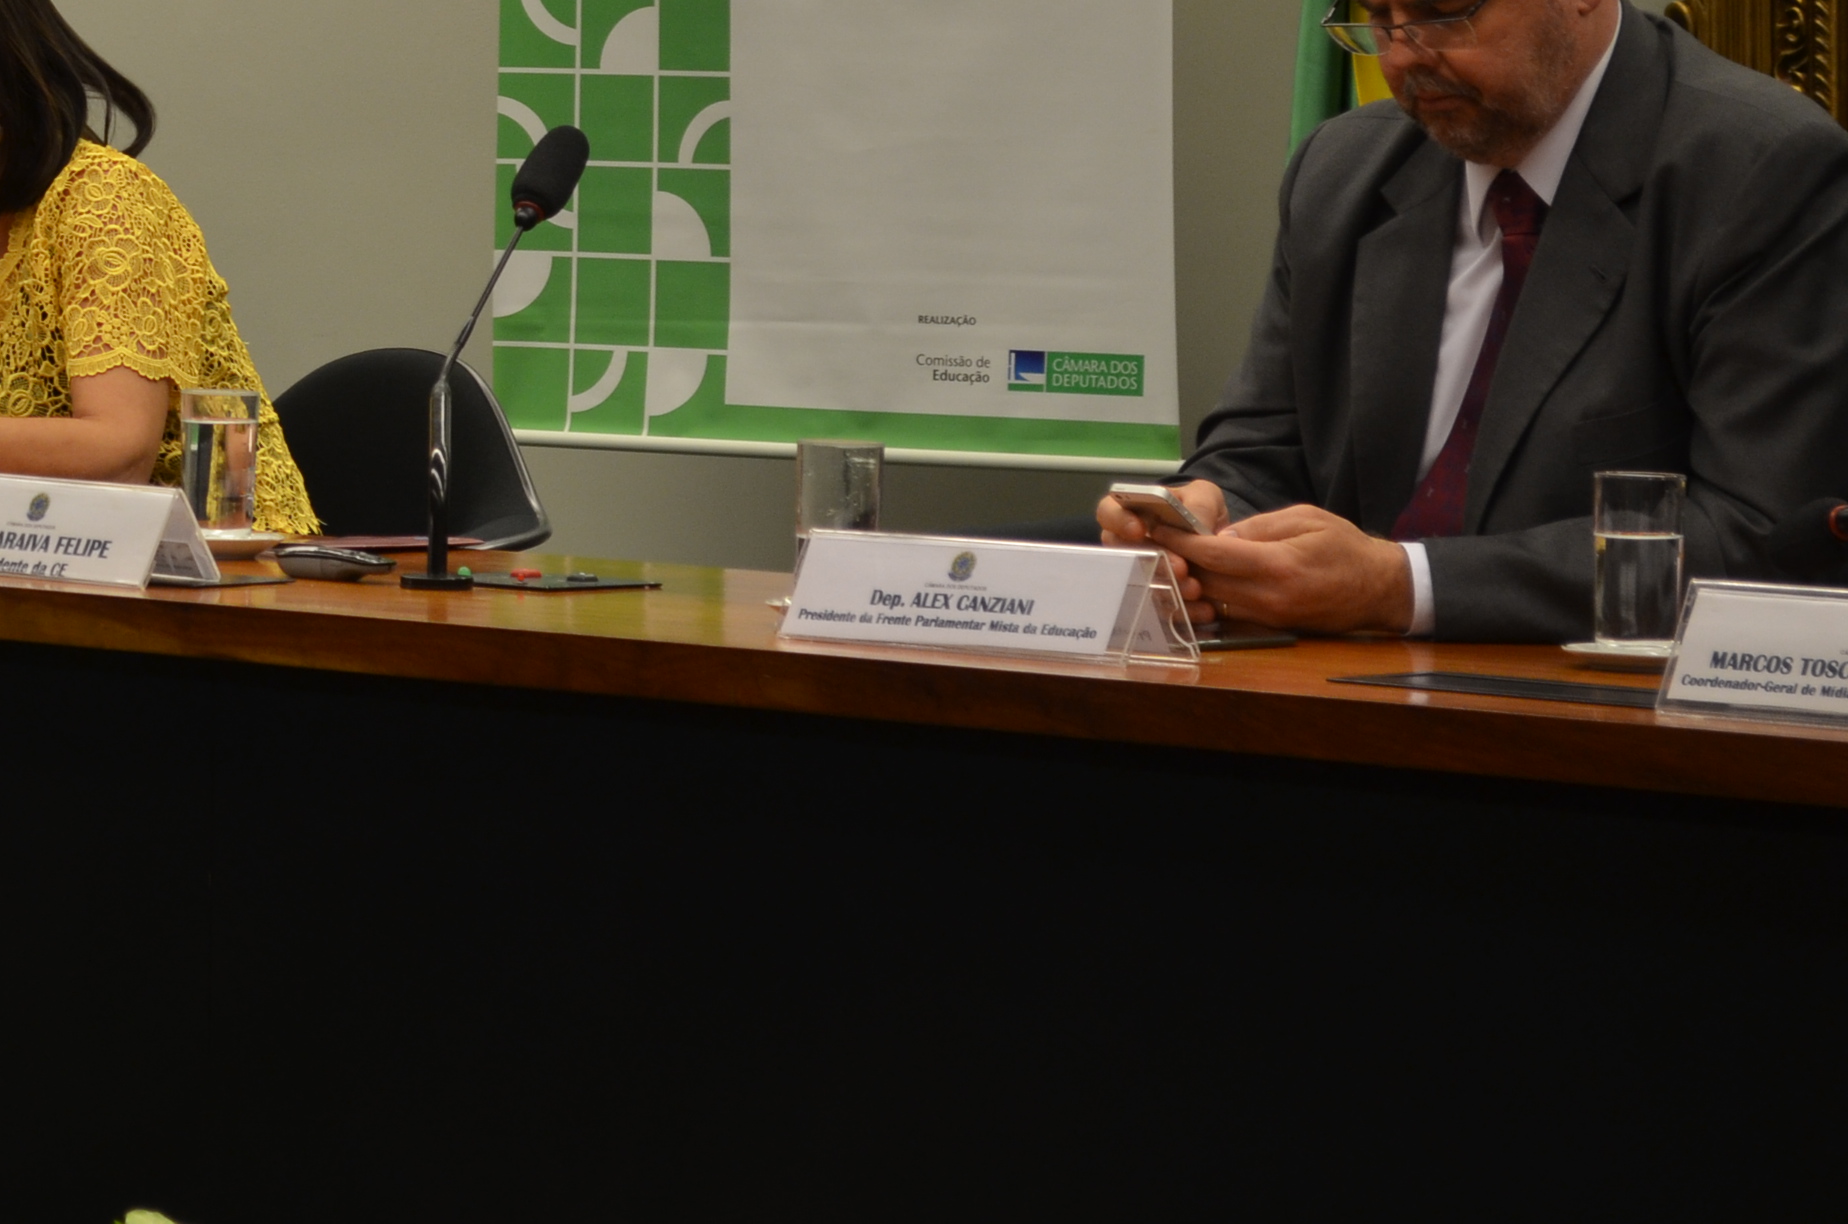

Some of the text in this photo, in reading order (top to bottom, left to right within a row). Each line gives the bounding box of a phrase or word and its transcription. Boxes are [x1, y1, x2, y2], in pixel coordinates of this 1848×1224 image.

[918, 314, 977, 327] REALIZAÇÃO
[915, 353, 991, 369] Comissão de
[1052, 357, 1138, 375] CÂMARA DOS
[932, 369, 990, 386] Educação
[1052, 374, 1138, 390] DEPUTADOS
[53, 536, 112, 558] FELIPE
[31, 560, 47, 575] da
[50, 562, 68, 577] CE
[870, 589, 1036, 616] Dep. ALEX CANZIANI
[798, 608, 1097, 641] Presidente da Frente Parlamentar Mista da Educação
[1709, 651, 1794, 675] MARCOS
[1681, 674, 1797, 695] Coordenador-Geral
[1801, 684, 1816, 696] de
